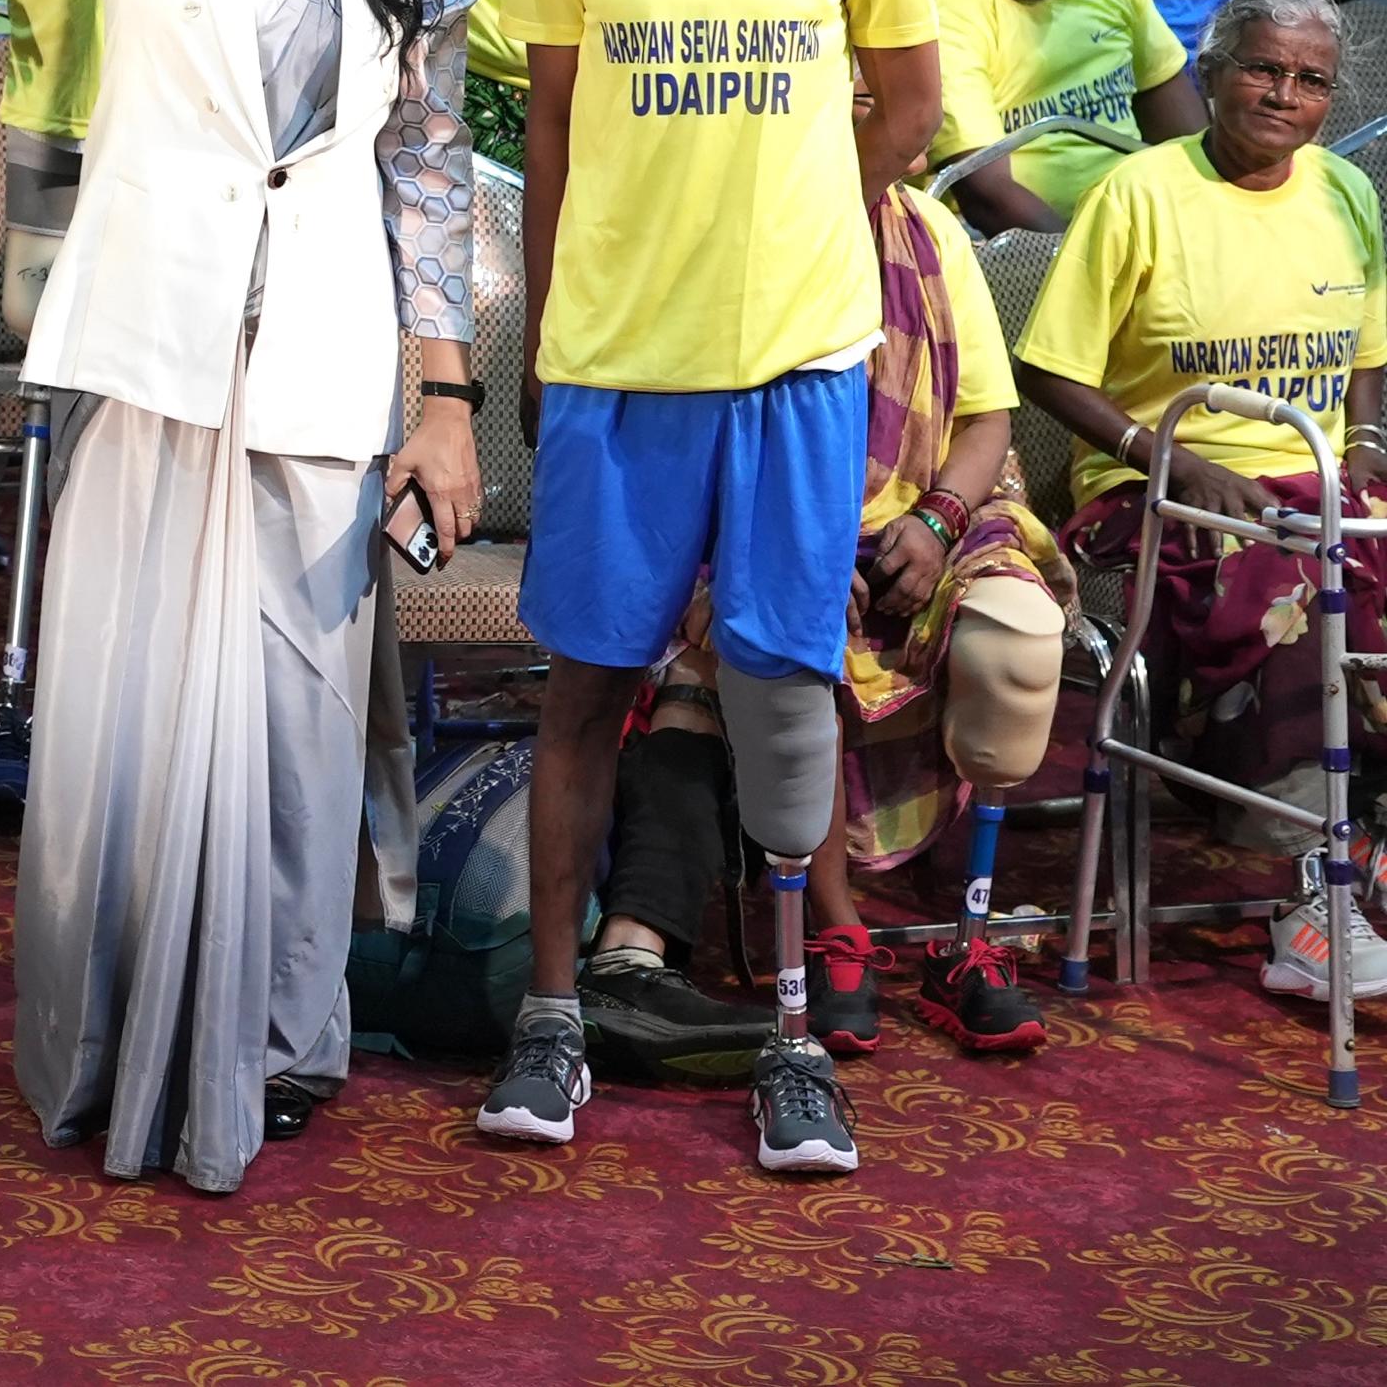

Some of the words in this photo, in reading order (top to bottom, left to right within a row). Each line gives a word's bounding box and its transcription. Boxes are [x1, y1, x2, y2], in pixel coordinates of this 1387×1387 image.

[602, 20, 674, 64] NARAYAN
[680, 19, 729, 62] SEVA
[735, 19, 822, 63] SANSTHAN
[631, 72, 792, 118] UDAIPUR
[1171, 334, 1253, 375] NARAYAN
[1256, 330, 1299, 371] SEVA
